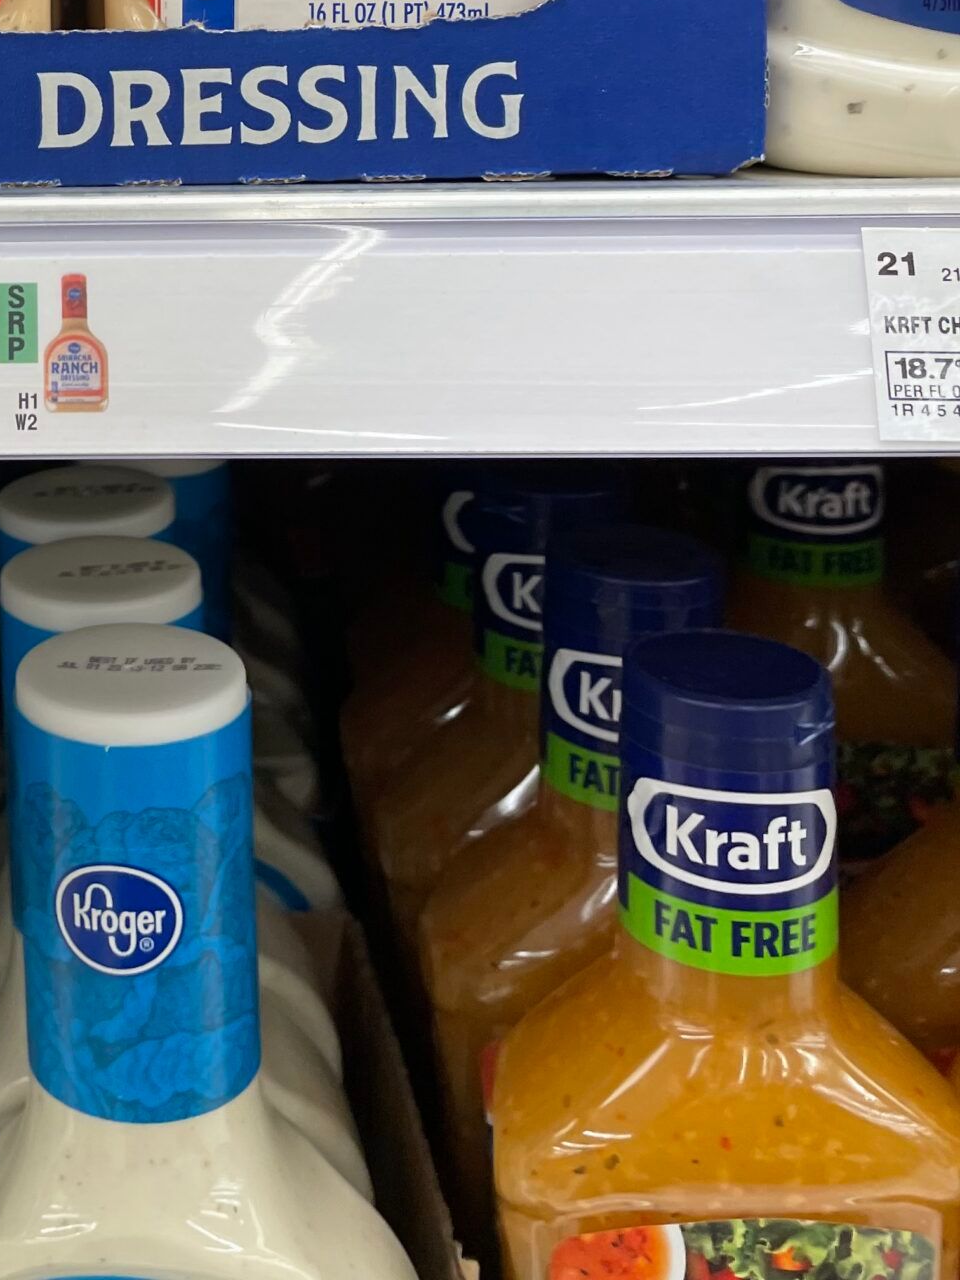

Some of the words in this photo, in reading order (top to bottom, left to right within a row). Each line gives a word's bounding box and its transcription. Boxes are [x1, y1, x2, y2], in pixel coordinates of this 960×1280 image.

[309, 2, 327, 22] 16
[332, 3, 350, 23] FL
[354, 2, 376, 23] OZ
[36, 61, 524, 149] DRESSING
[877, 251, 916, 276] 21
[884, 316, 932, 334] KRFT
[51, 362, 99, 374] RANCH
[18, 393, 38, 410] H1
[894, 385, 923, 398] PER
[929, 385, 946, 398] FL
[15, 414, 38, 431] W2
[778, 480, 872, 518] Kraft
[664, 803, 808, 871] Kraft
[73, 883, 165, 956] Kroger
[654, 898, 718, 954] FAT
[731, 913, 817, 958] FREE
